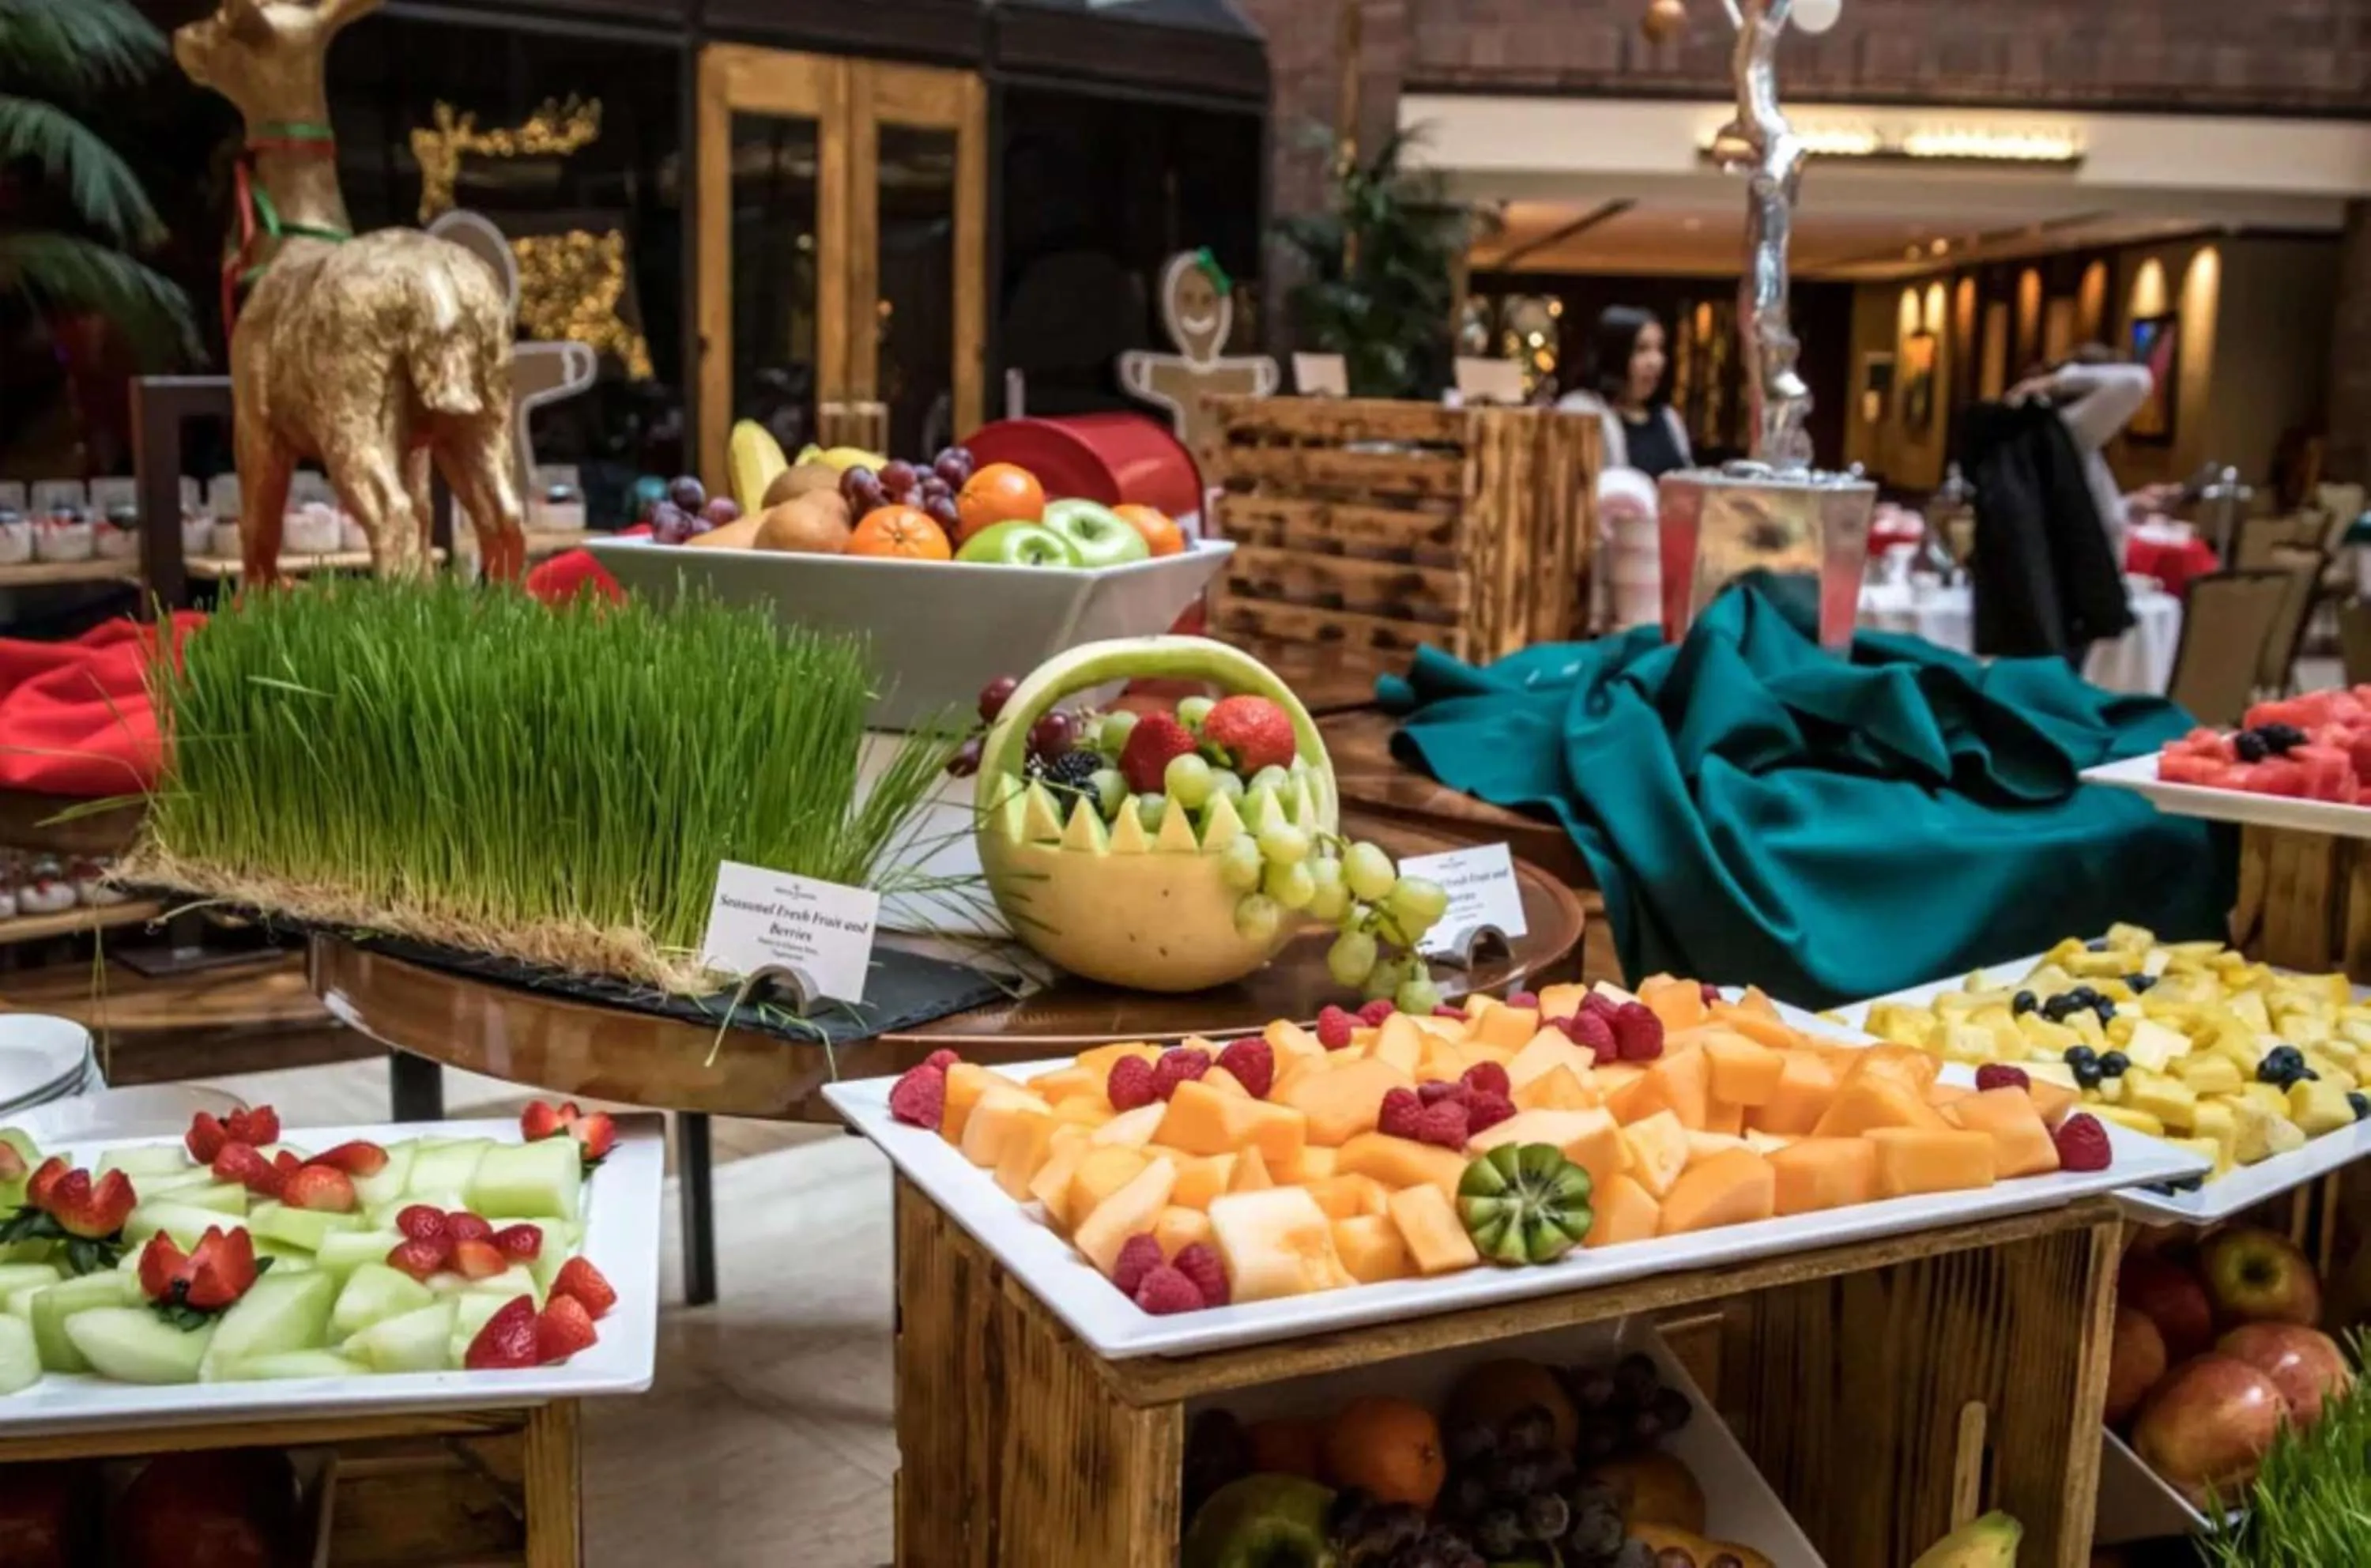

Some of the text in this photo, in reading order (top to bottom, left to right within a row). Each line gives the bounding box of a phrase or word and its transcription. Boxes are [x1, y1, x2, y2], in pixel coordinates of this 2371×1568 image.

[718, 893, 869, 934] Seasonal Fresh Fruit and
[769, 921, 812, 942] Berries
